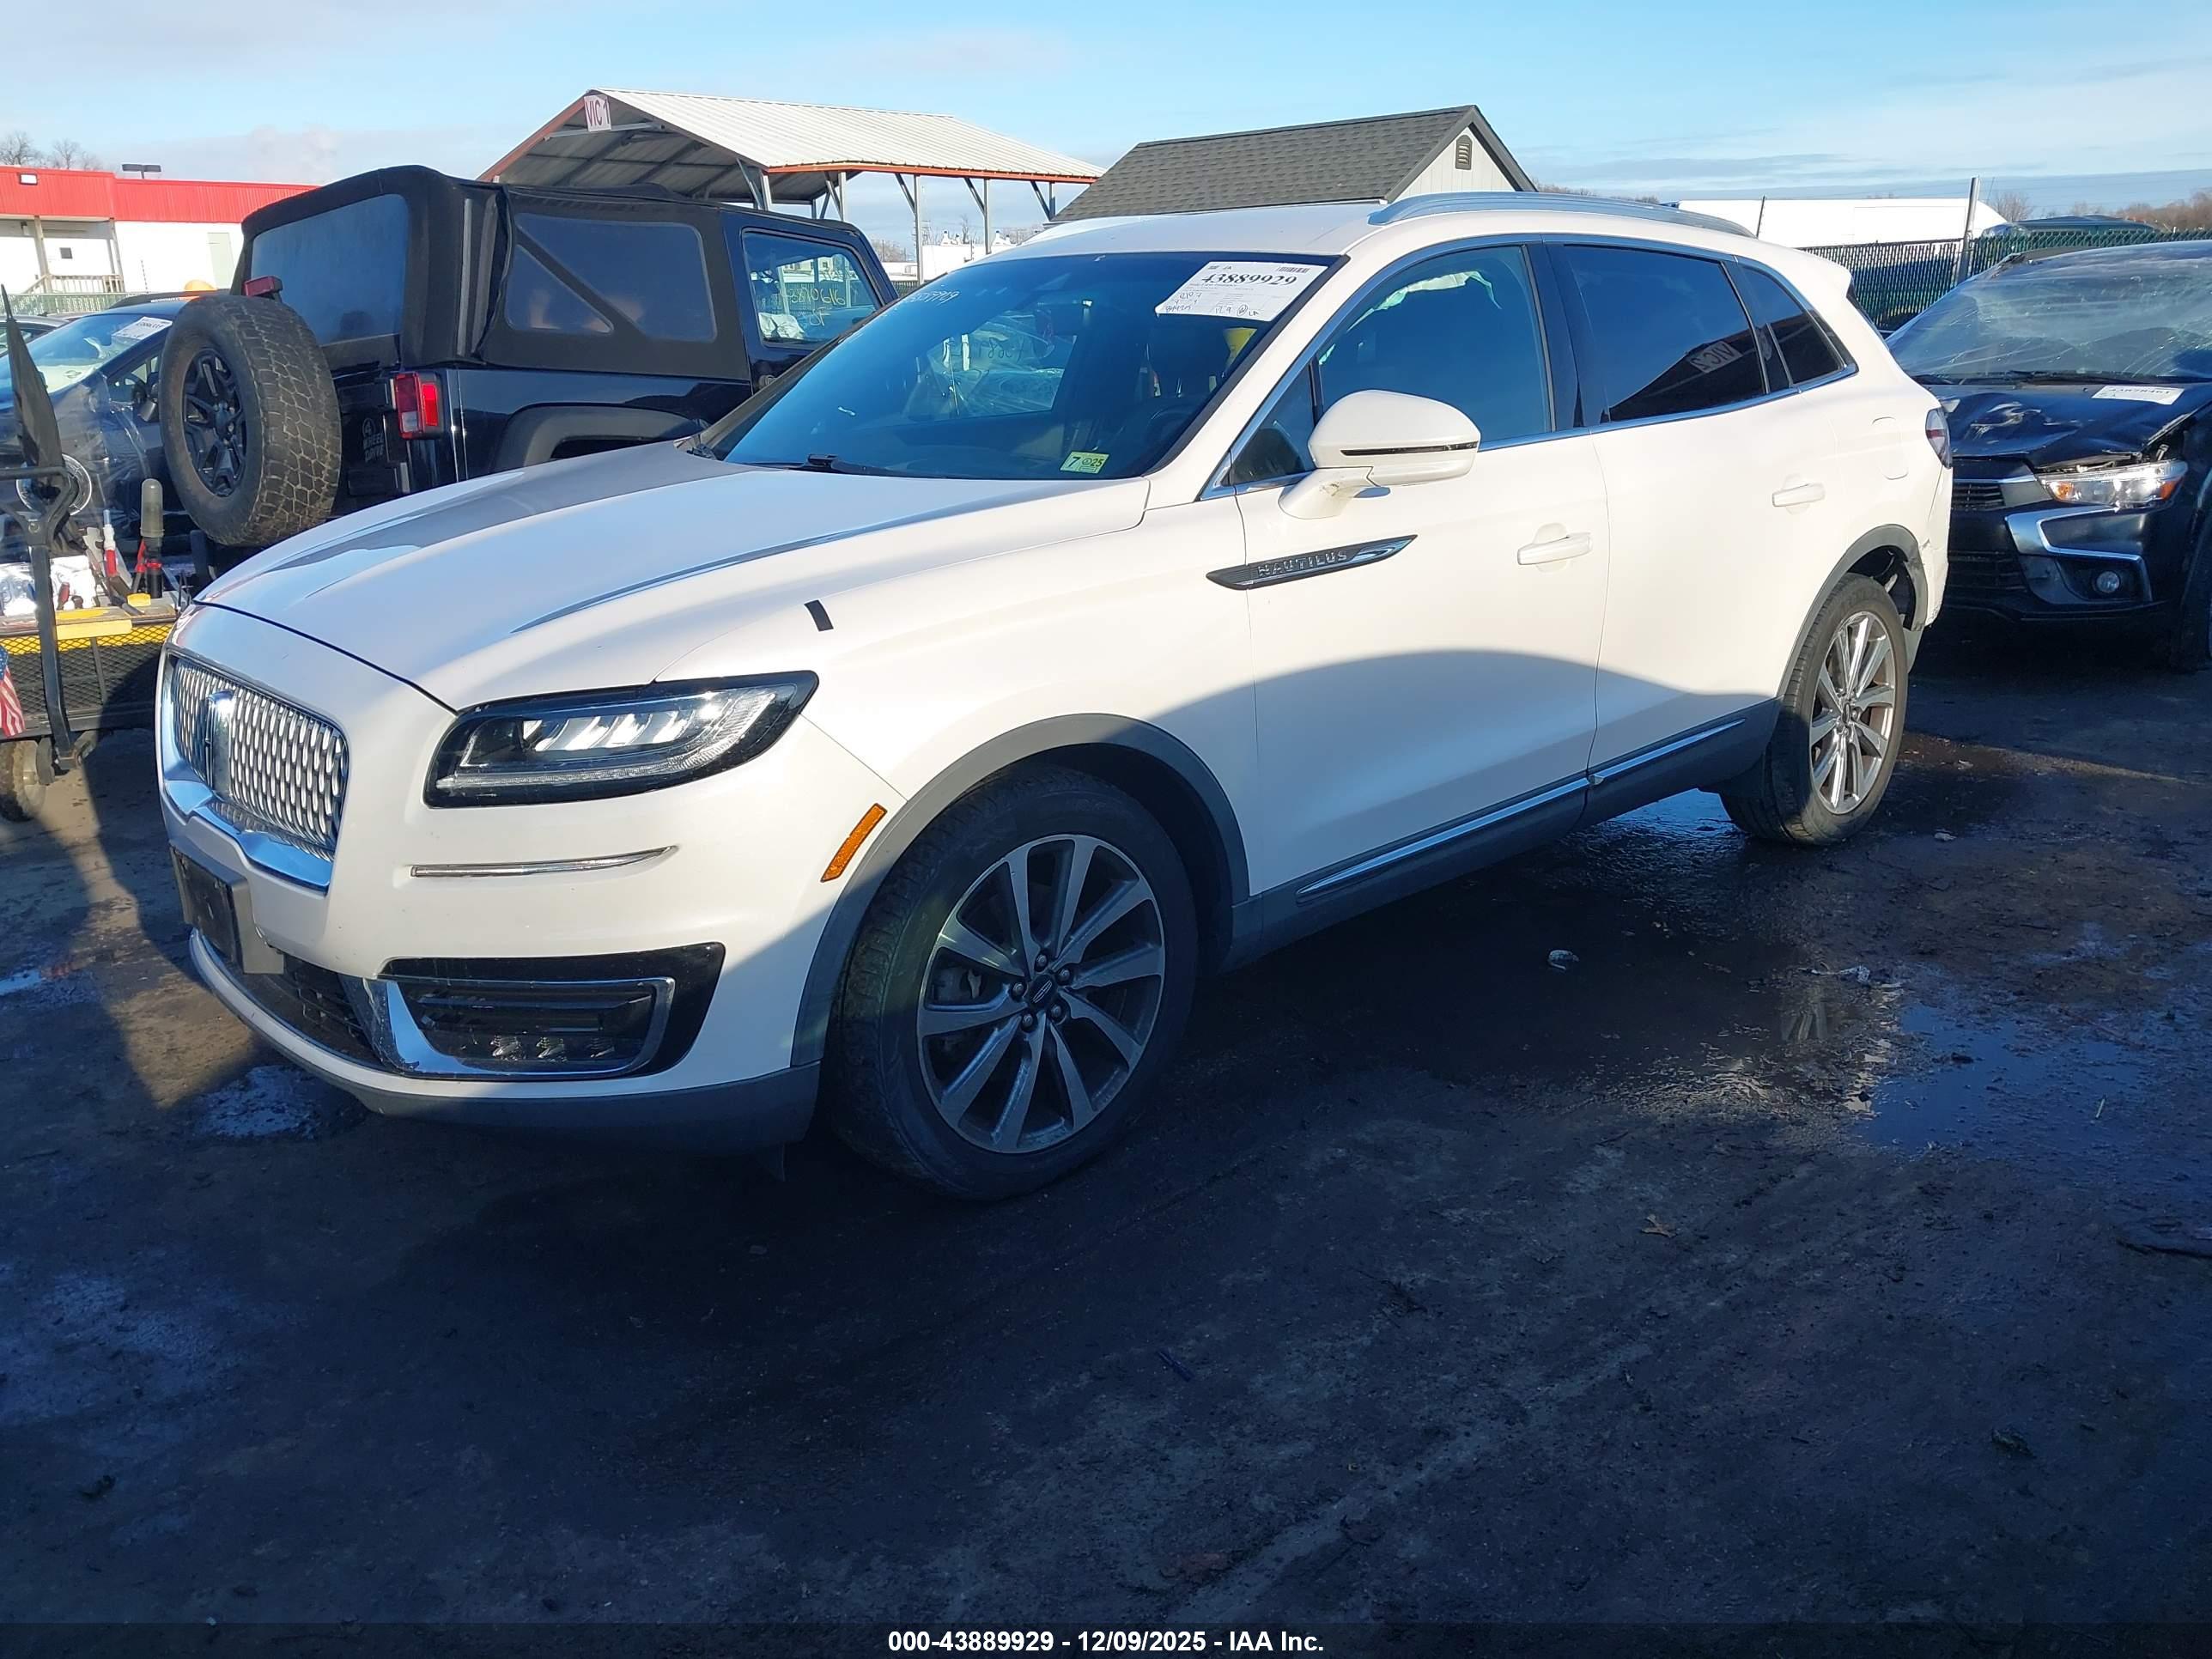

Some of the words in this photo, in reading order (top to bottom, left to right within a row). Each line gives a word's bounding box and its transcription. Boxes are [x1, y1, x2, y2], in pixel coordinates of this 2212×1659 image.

[585, 100, 603, 126] VIC
[604, 99, 611, 125] 1
[1202, 273, 1297, 286] 43889929
[1068, 456, 1081, 467] 7
[1091, 458, 1104, 467] 25
[1257, 550, 1347, 577] NAUTILUS
